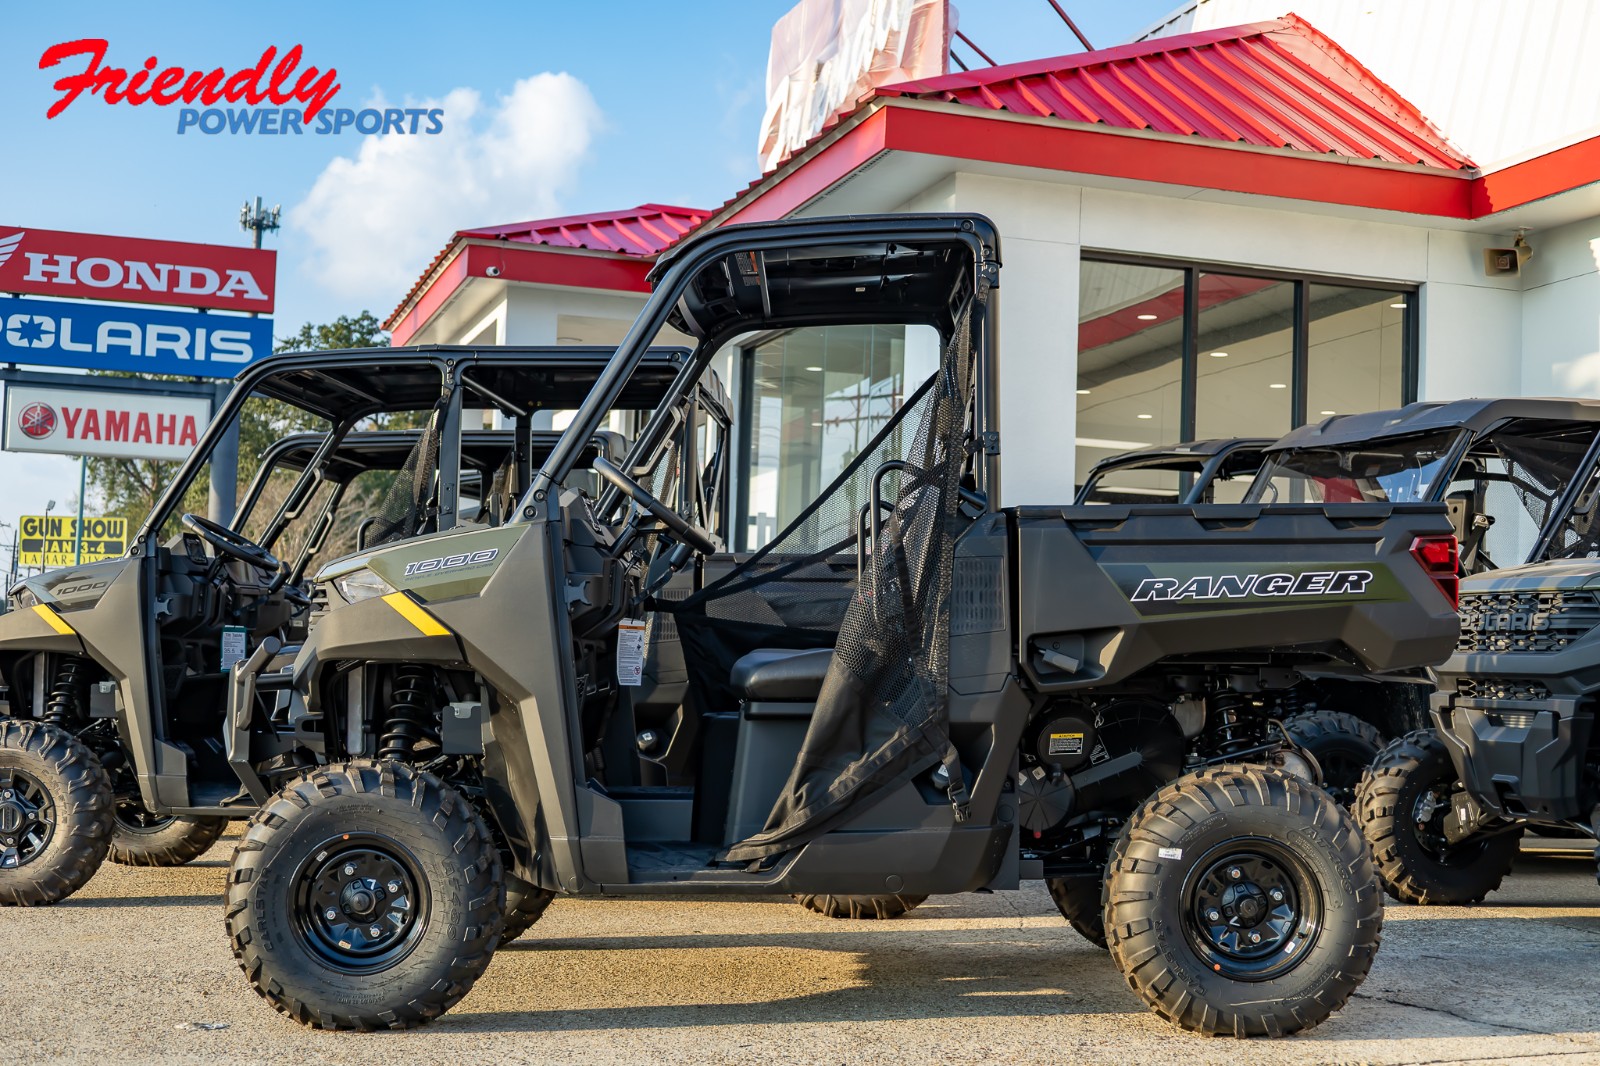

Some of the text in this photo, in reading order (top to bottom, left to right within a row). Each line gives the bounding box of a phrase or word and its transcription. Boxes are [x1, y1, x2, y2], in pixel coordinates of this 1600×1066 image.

[23, 252, 268, 300] HONDA
[0, 314, 254, 363] OLARIS
[61, 406, 199, 446] YAMAHA
[23, 518, 62, 537] GUN
[80, 541, 105, 554] 3-4
[405, 548, 498, 576] 1000
[56, 581, 108, 596] 1000
[1131, 570, 1373, 601] RANGER
